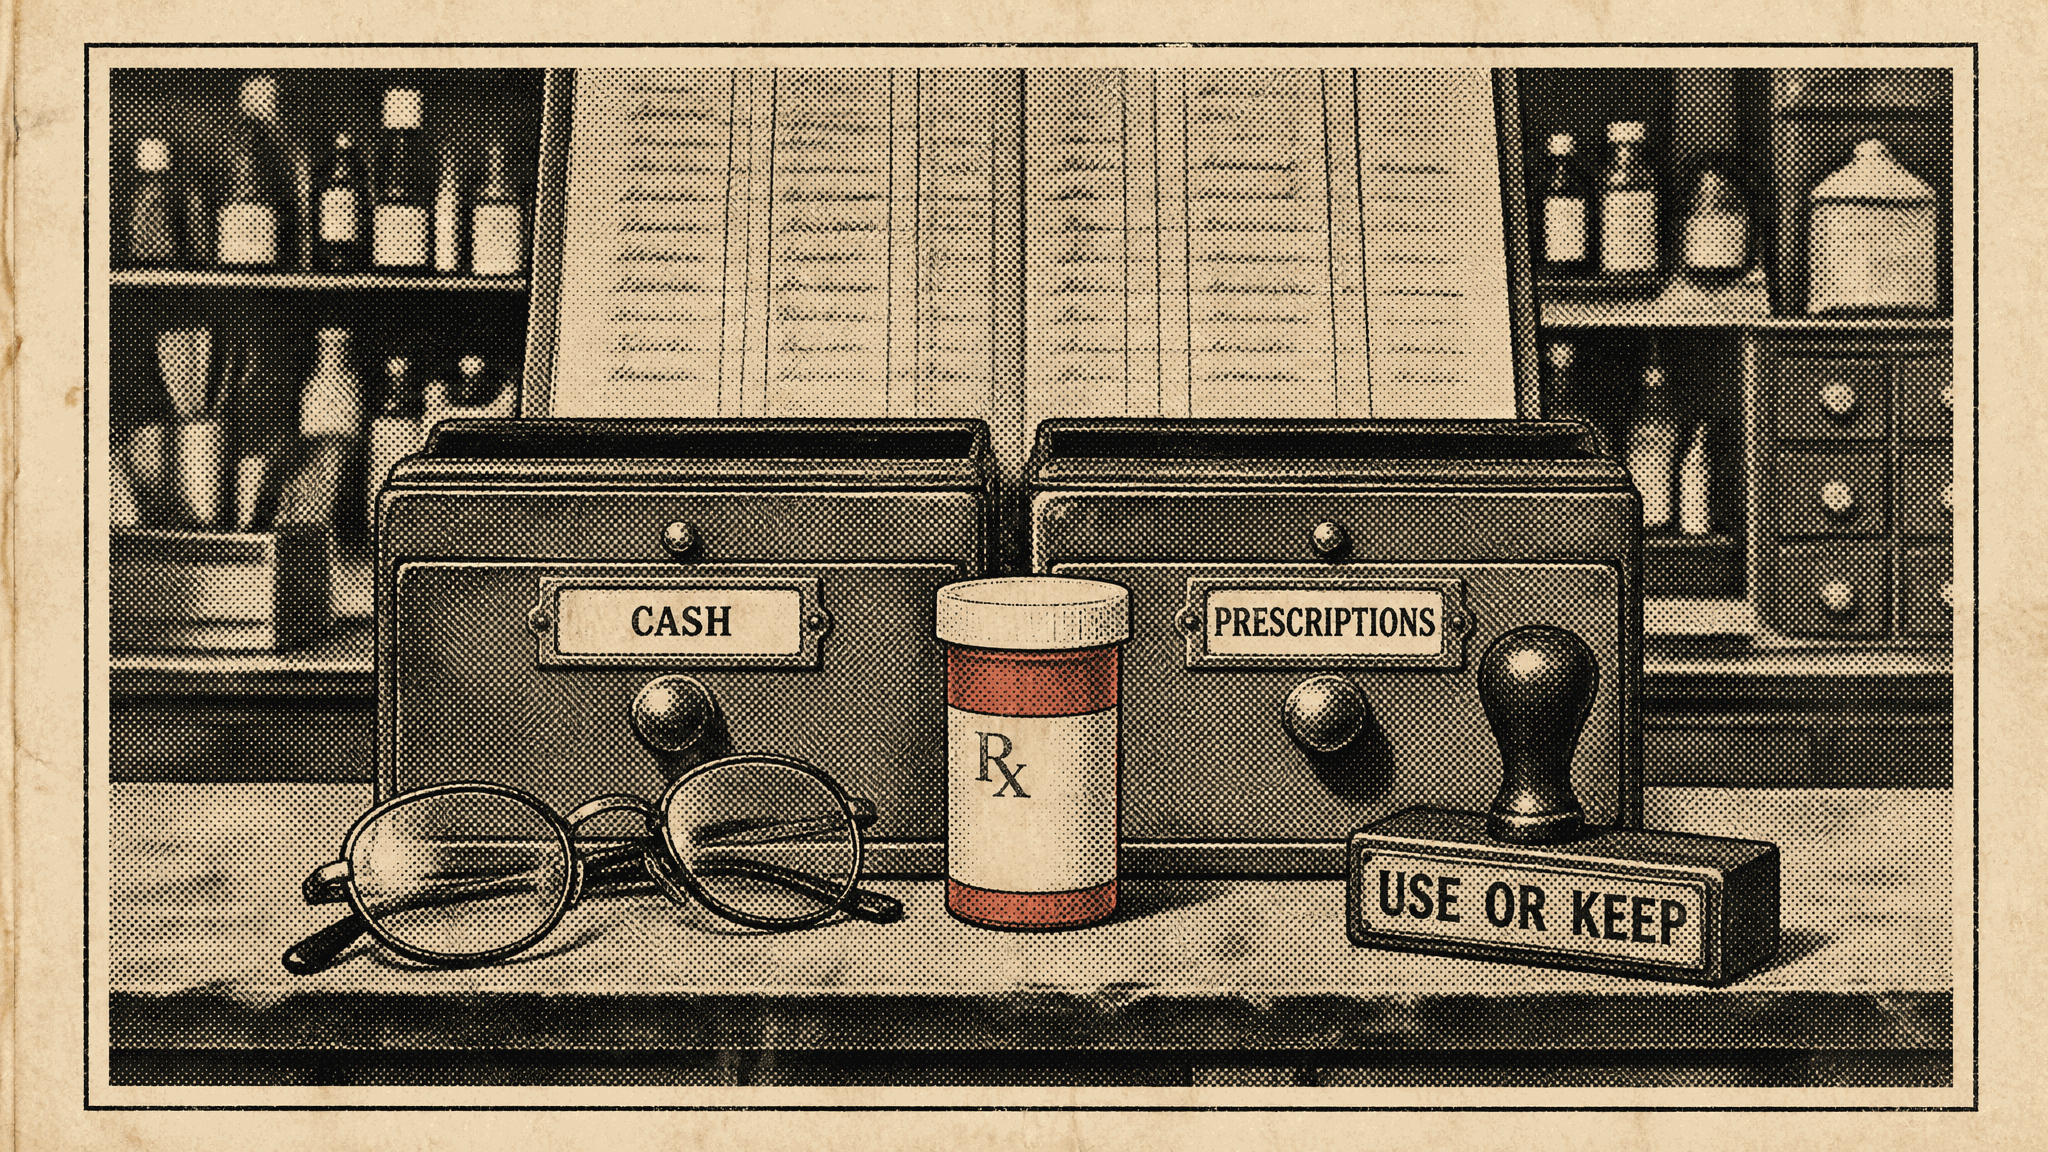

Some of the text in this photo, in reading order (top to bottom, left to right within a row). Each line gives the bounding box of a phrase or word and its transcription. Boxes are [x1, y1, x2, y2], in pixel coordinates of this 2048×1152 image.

[631, 605, 732, 637] CASH
[1214, 606, 1436, 638] PRESCRIPTIONS
[974, 731, 1032, 798] Rx
[1378, 869, 1688, 946] USE OR KEEP
